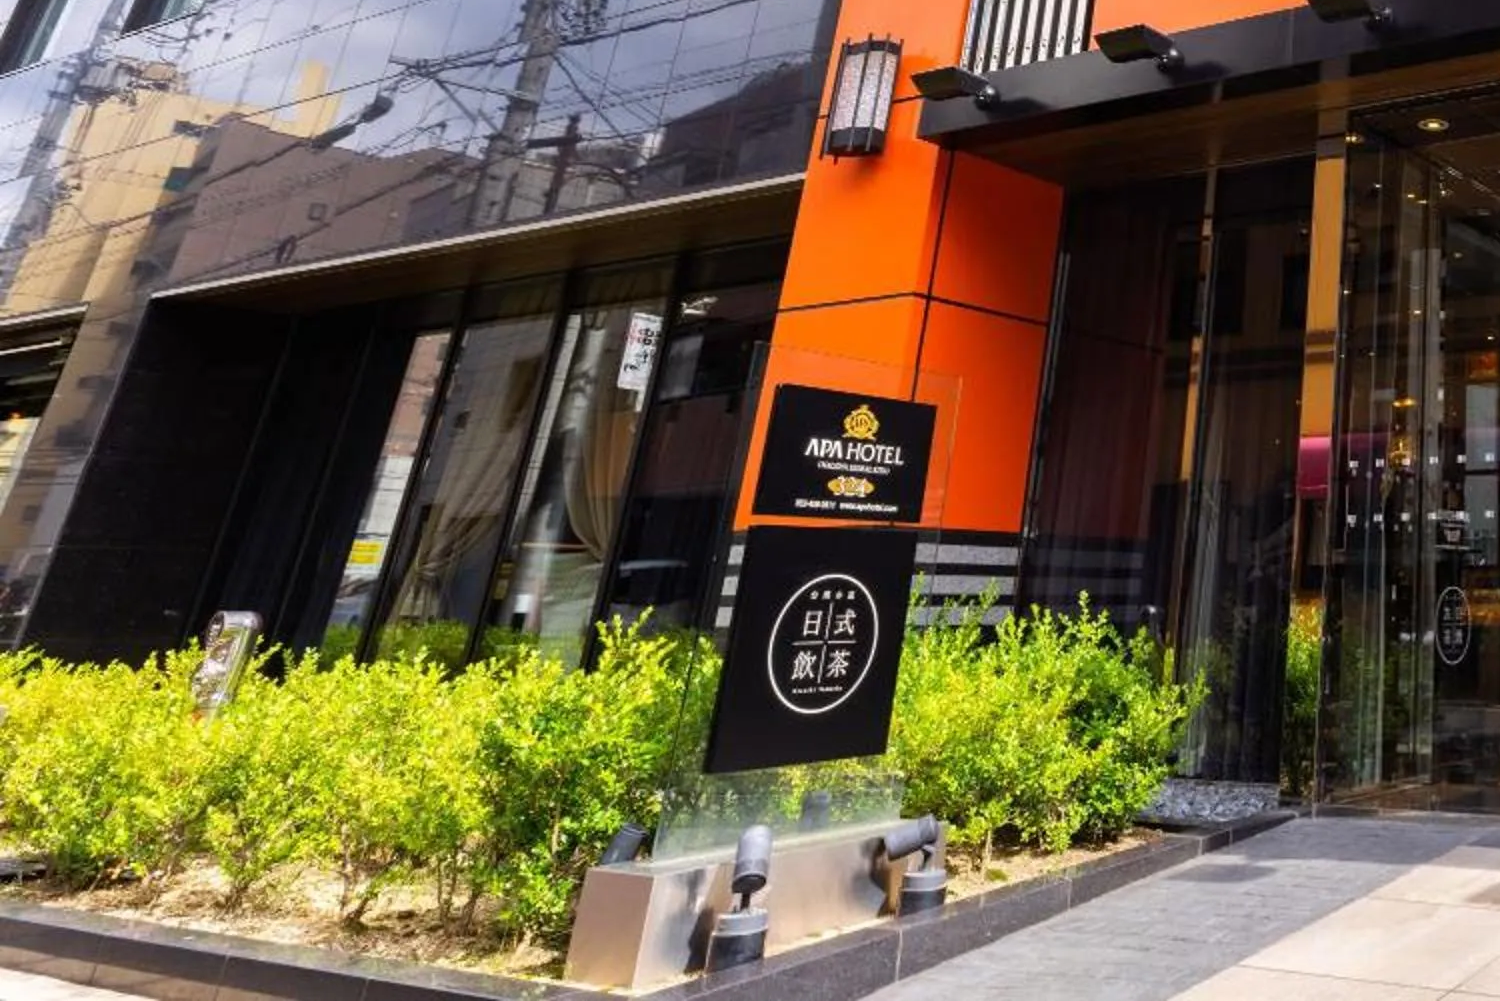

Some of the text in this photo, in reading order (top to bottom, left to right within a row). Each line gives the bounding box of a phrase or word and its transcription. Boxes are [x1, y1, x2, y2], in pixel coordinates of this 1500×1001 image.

[804, 438, 905, 466] APA HOTEL
[802, 607, 858, 637] 日式
